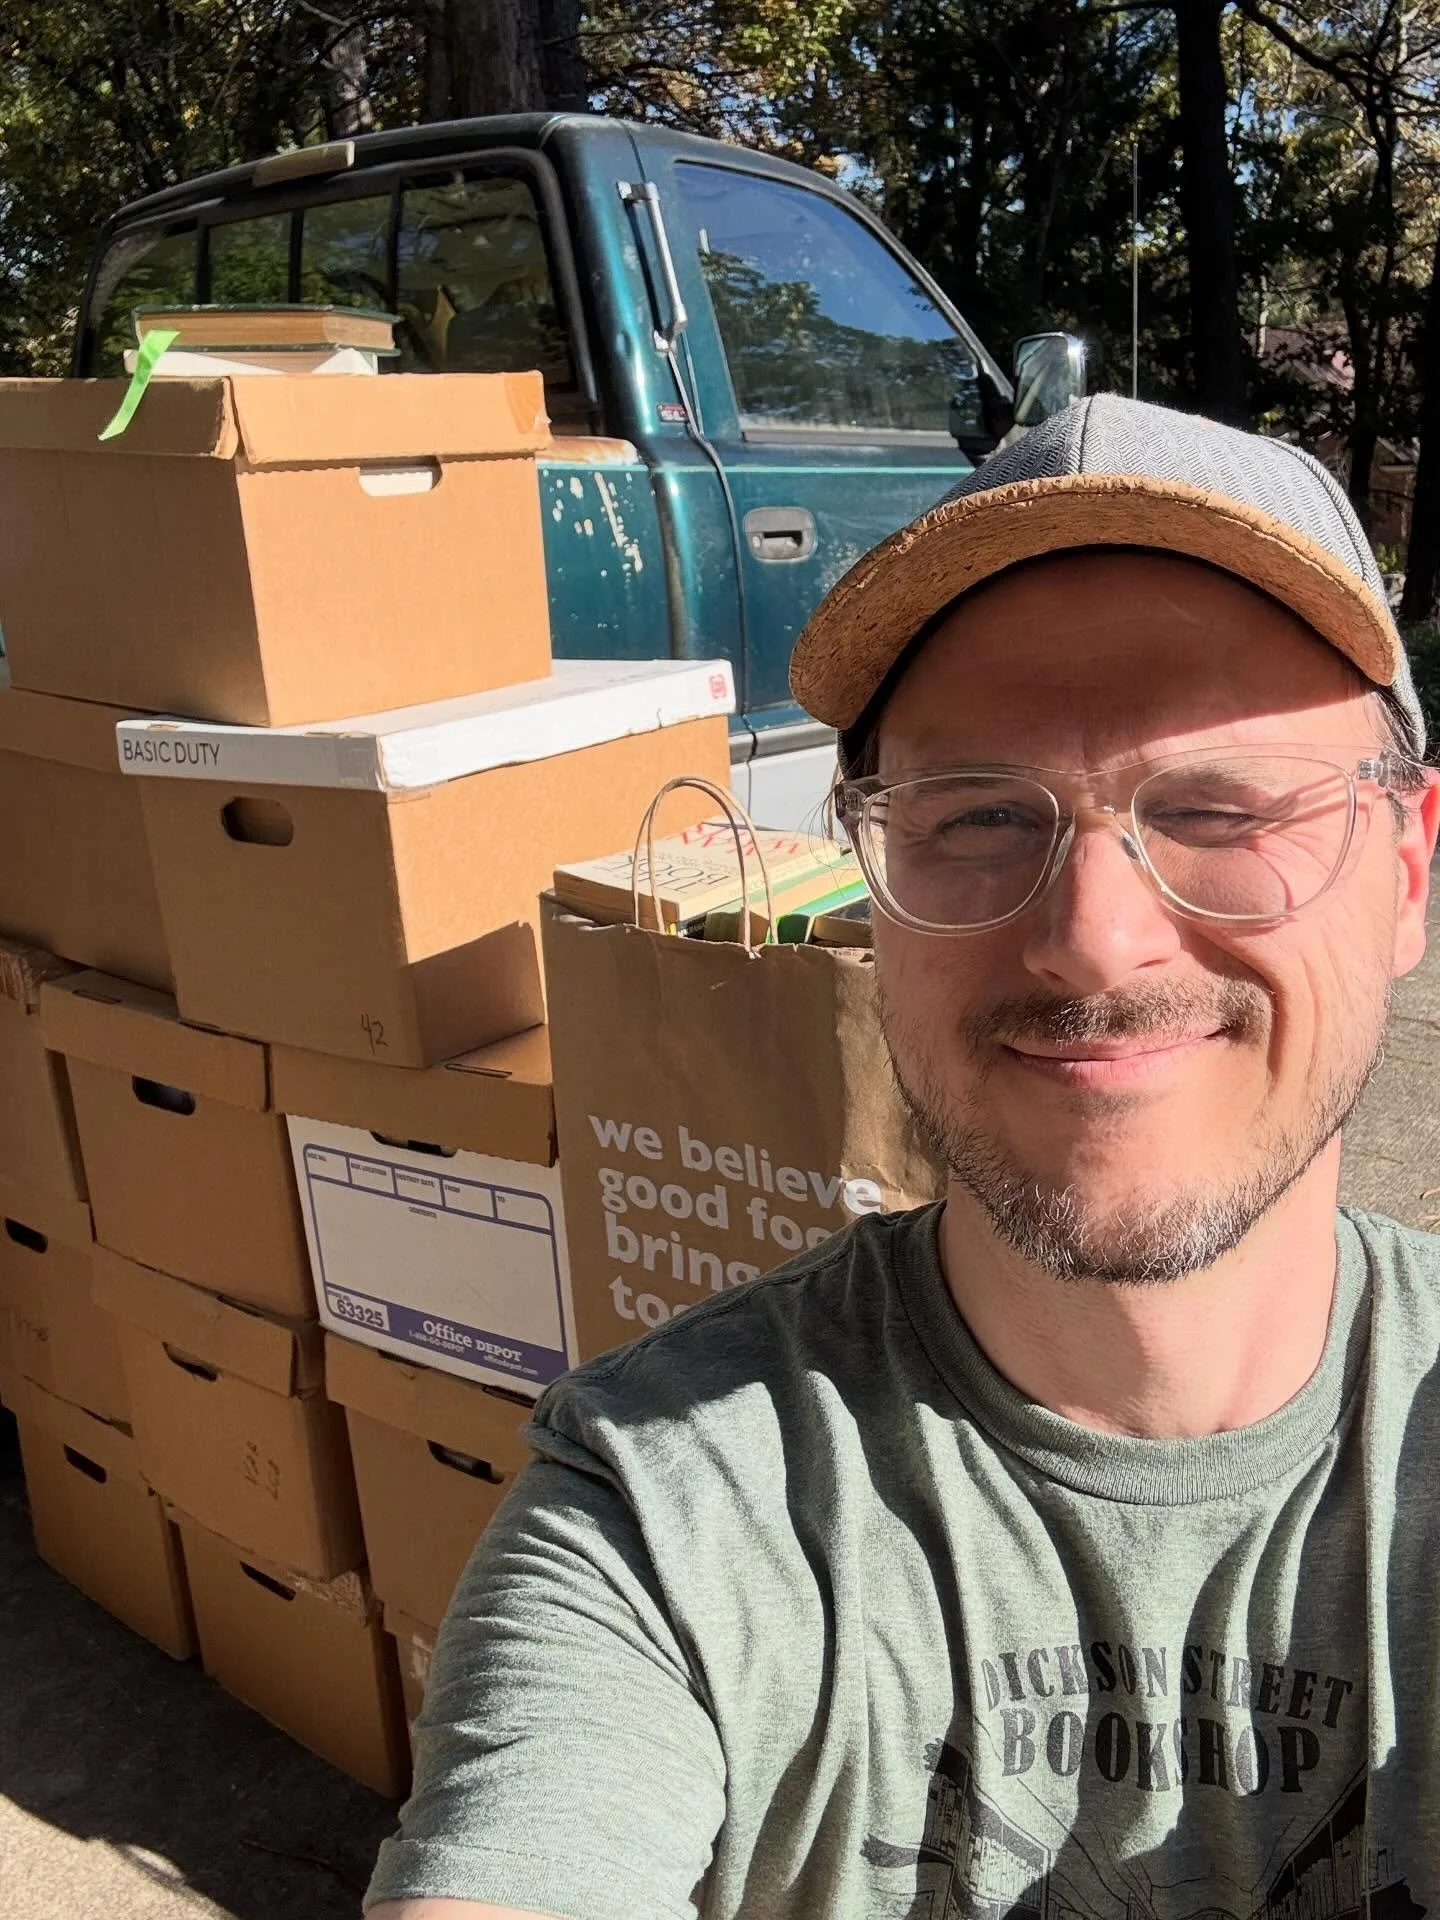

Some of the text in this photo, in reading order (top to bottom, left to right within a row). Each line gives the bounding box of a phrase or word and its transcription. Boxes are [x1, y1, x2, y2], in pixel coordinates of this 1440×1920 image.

[123, 739, 220, 766] BASIC DUTY
[360, 1013, 389, 1056] 42
[588, 1115, 882, 1215] we believe
[599, 1167, 729, 1231] good
[337, 1299, 384, 1327] 63325
[608, 1275, 691, 1329] to
[422, 1320, 522, 1362] Office DEPOT
[981, 1640, 1353, 1729] DICKSON STREET
[1000, 1707, 1321, 1797] BOOKSHOP
